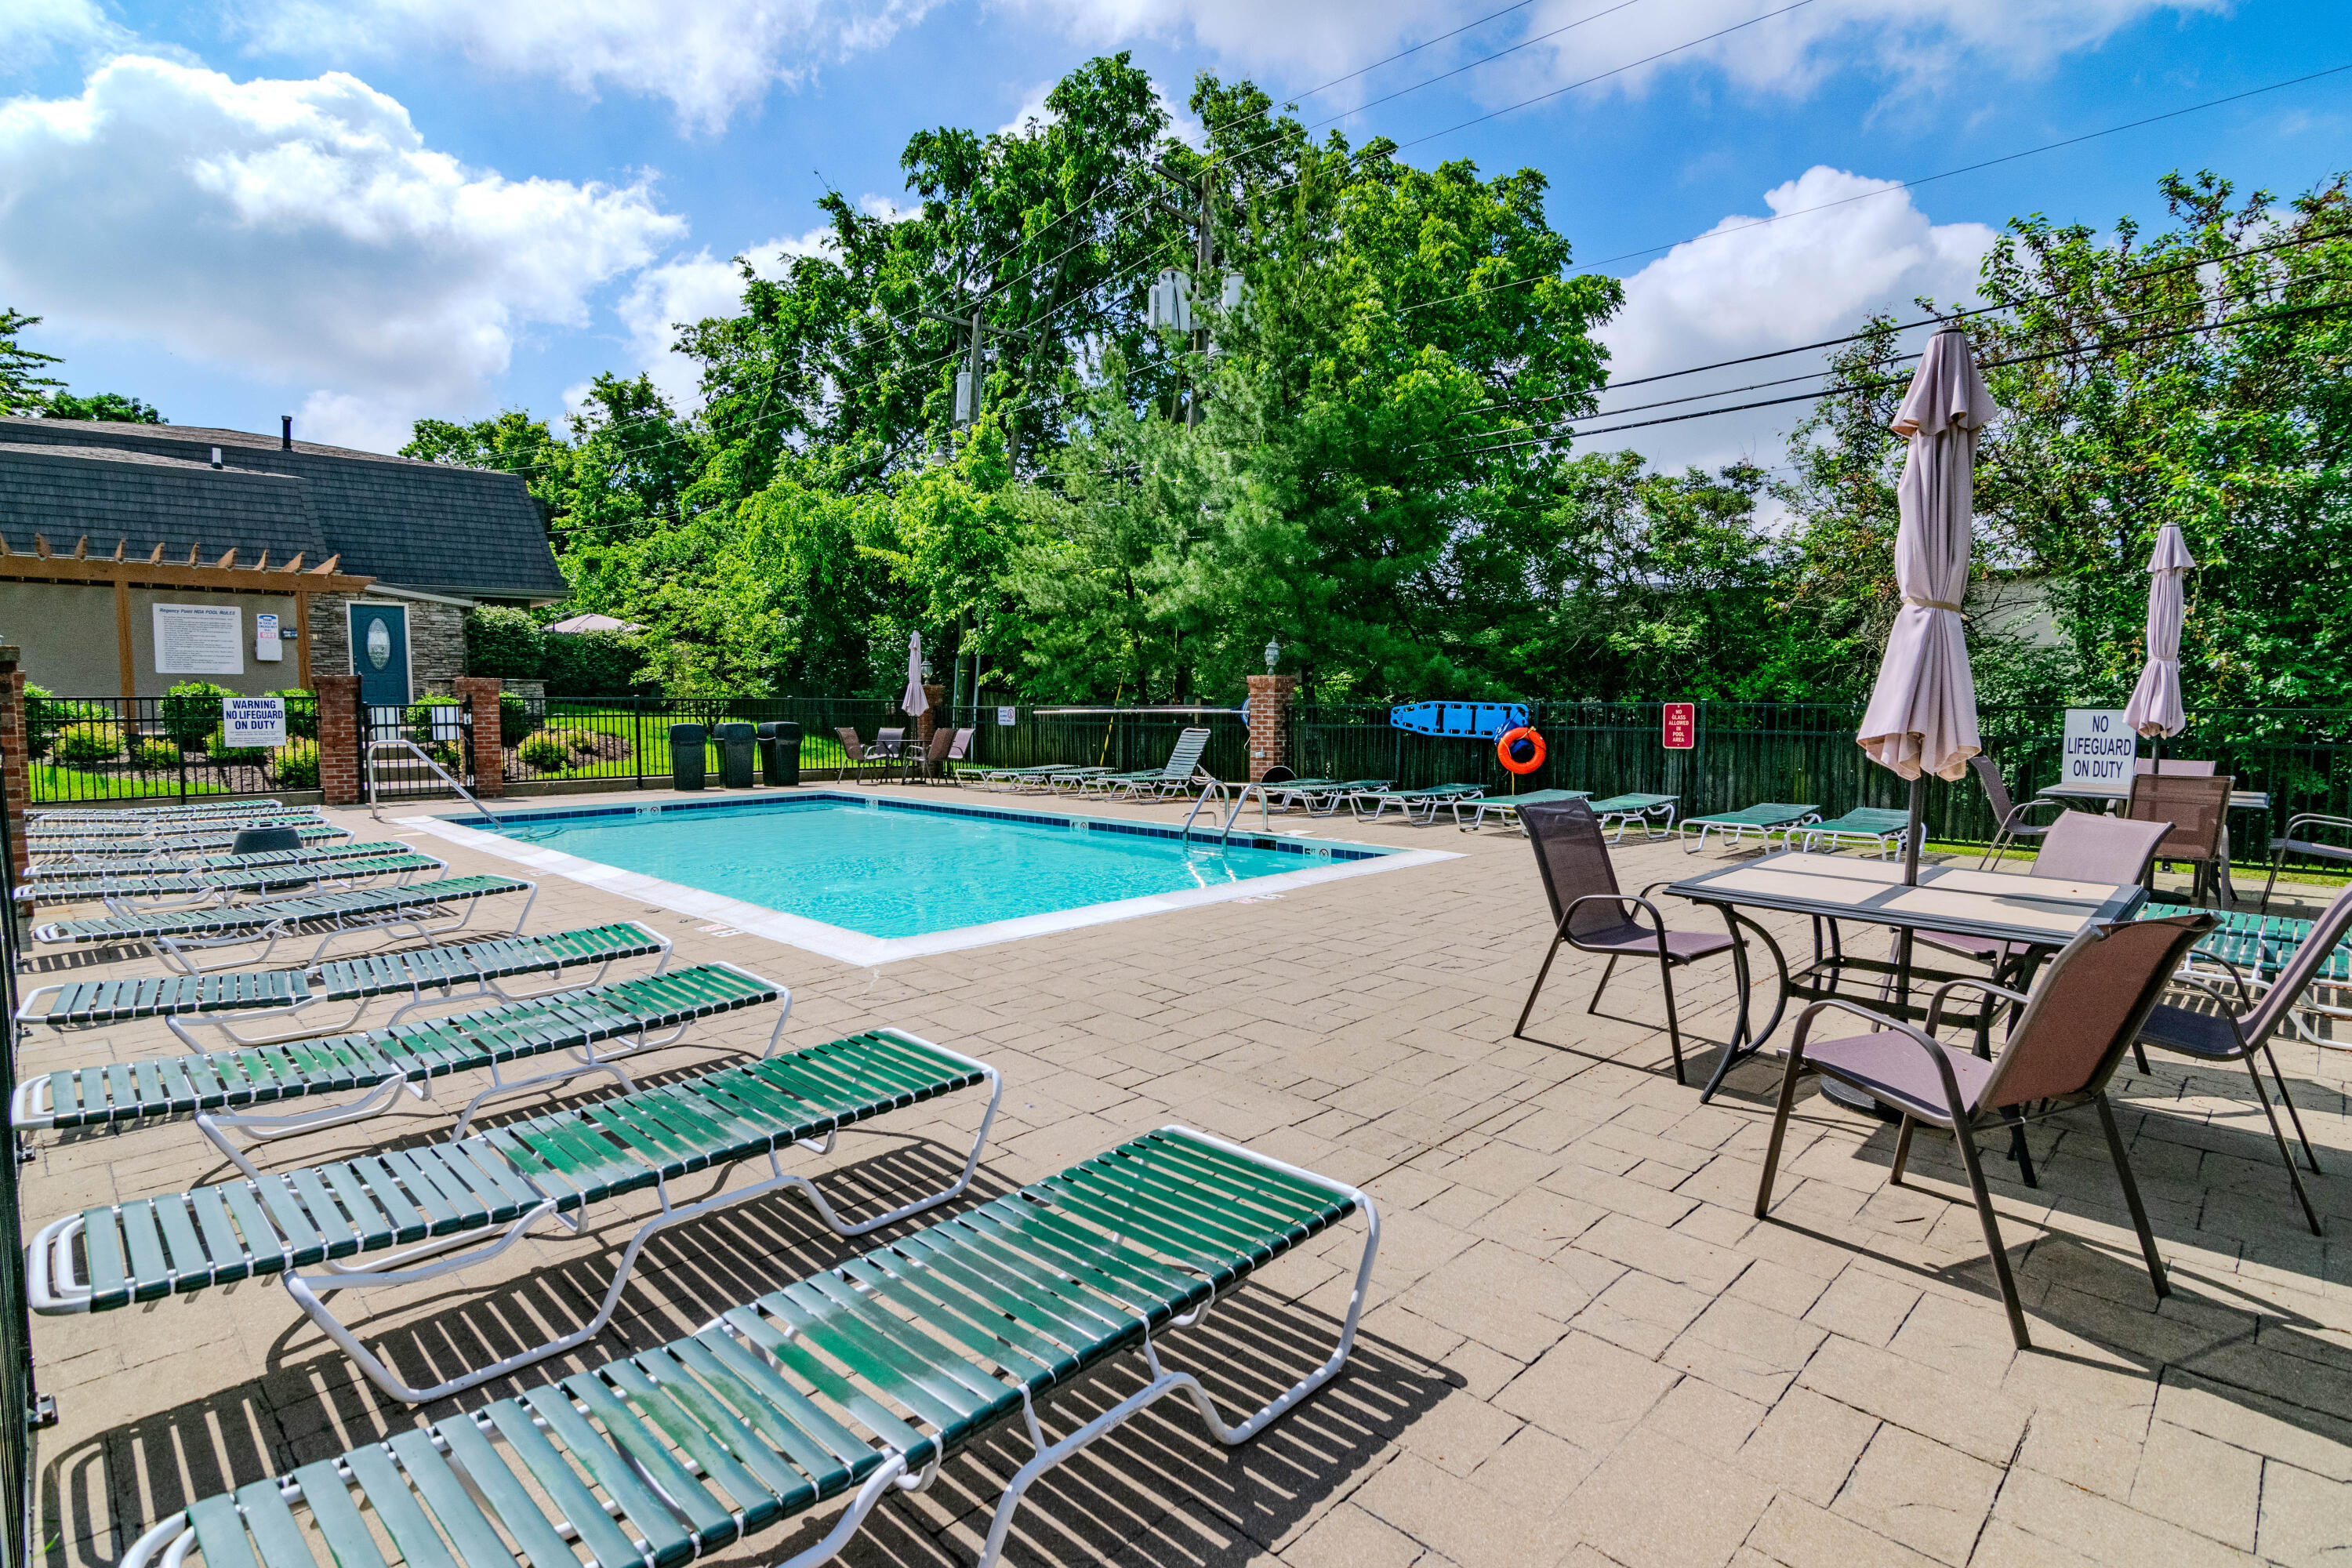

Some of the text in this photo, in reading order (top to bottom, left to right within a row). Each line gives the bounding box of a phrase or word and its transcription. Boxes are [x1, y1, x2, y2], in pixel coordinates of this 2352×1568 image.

[232, 700, 276, 710] WARNING
[226, 710, 283, 720] NO LIFEGUARD
[235, 720, 275, 729] ON DUTY
[2092, 715, 2109, 732] NO
[2067, 737, 2132, 756] LIFEGUARD
[2073, 760, 2123, 779] ON DUTY
